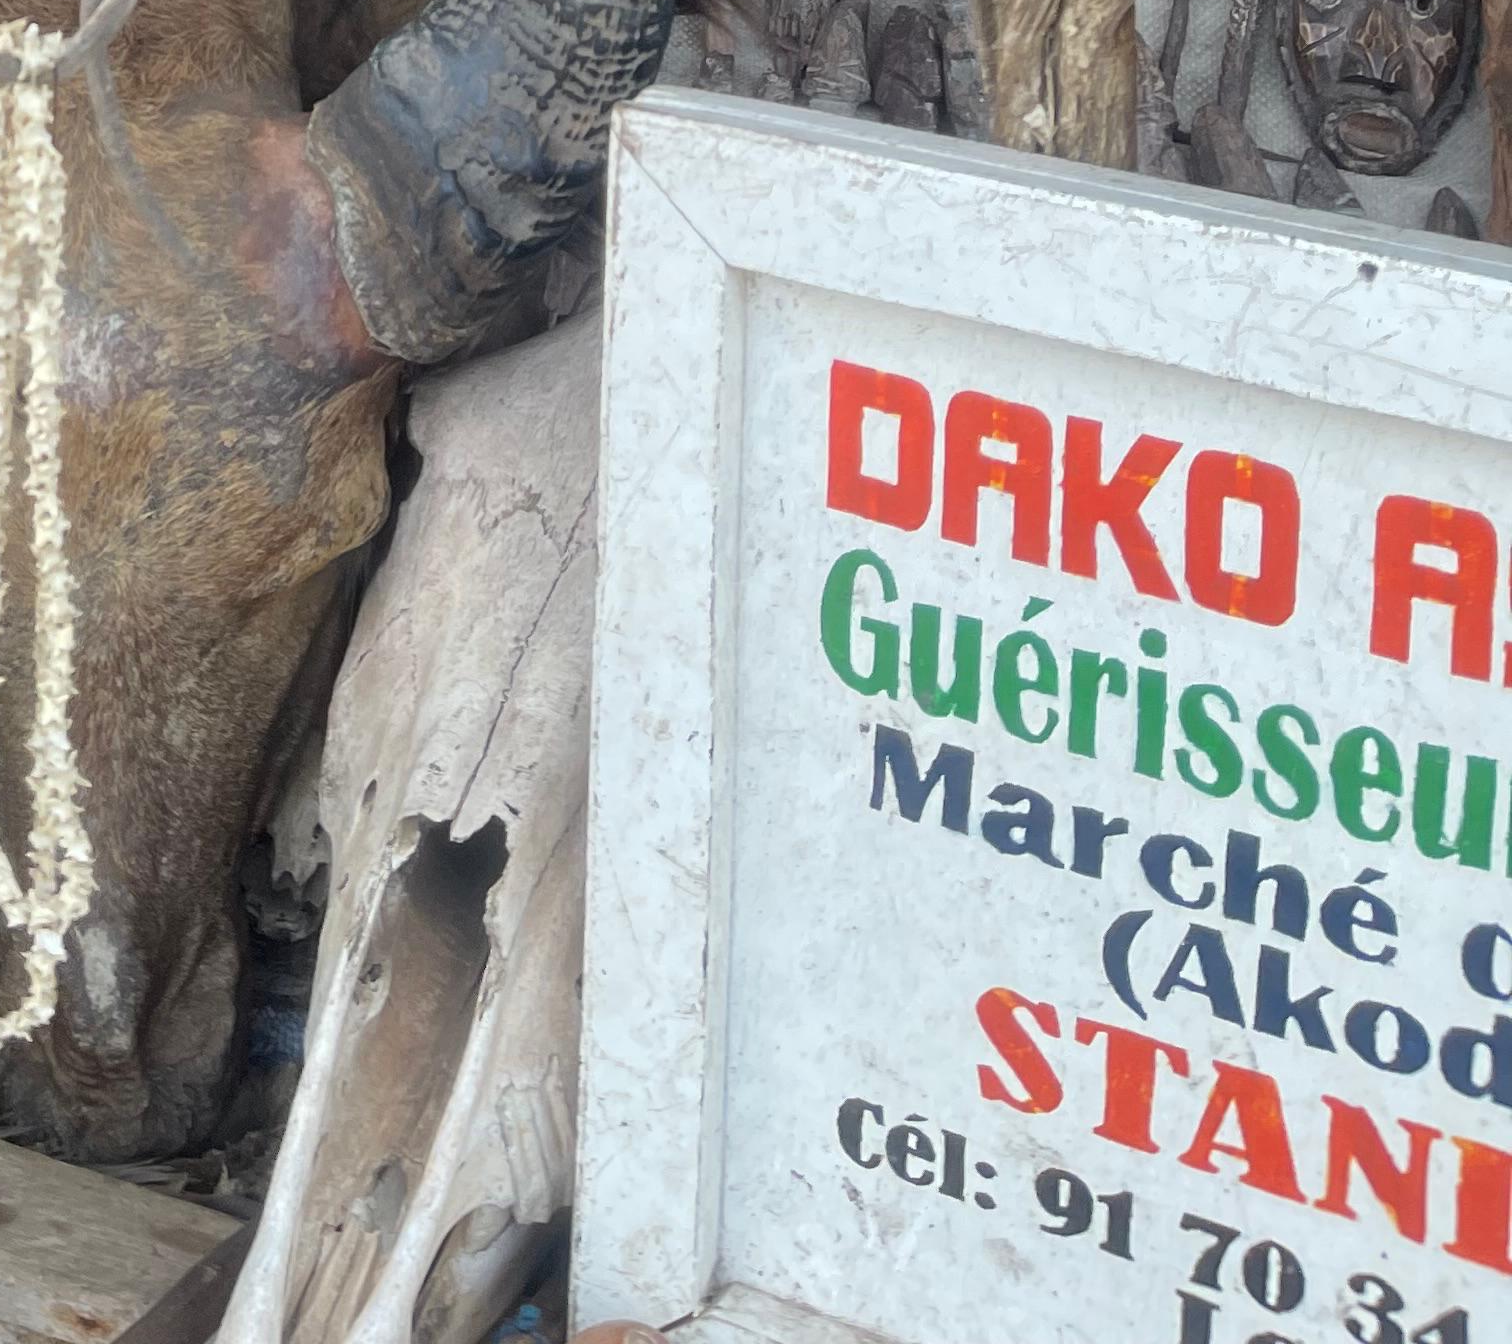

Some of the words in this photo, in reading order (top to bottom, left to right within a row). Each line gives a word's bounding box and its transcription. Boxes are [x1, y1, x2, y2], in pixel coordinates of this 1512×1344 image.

[825, 358, 1301, 628] DAKO
[820, 549, 1512, 878] Guérisseu
[868, 723, 1399, 966] Marché
[836, 1097, 999, 1210] Cél:
[1036, 1167, 1135, 1261] 91
[1179, 1212, 1305, 1314] 70
